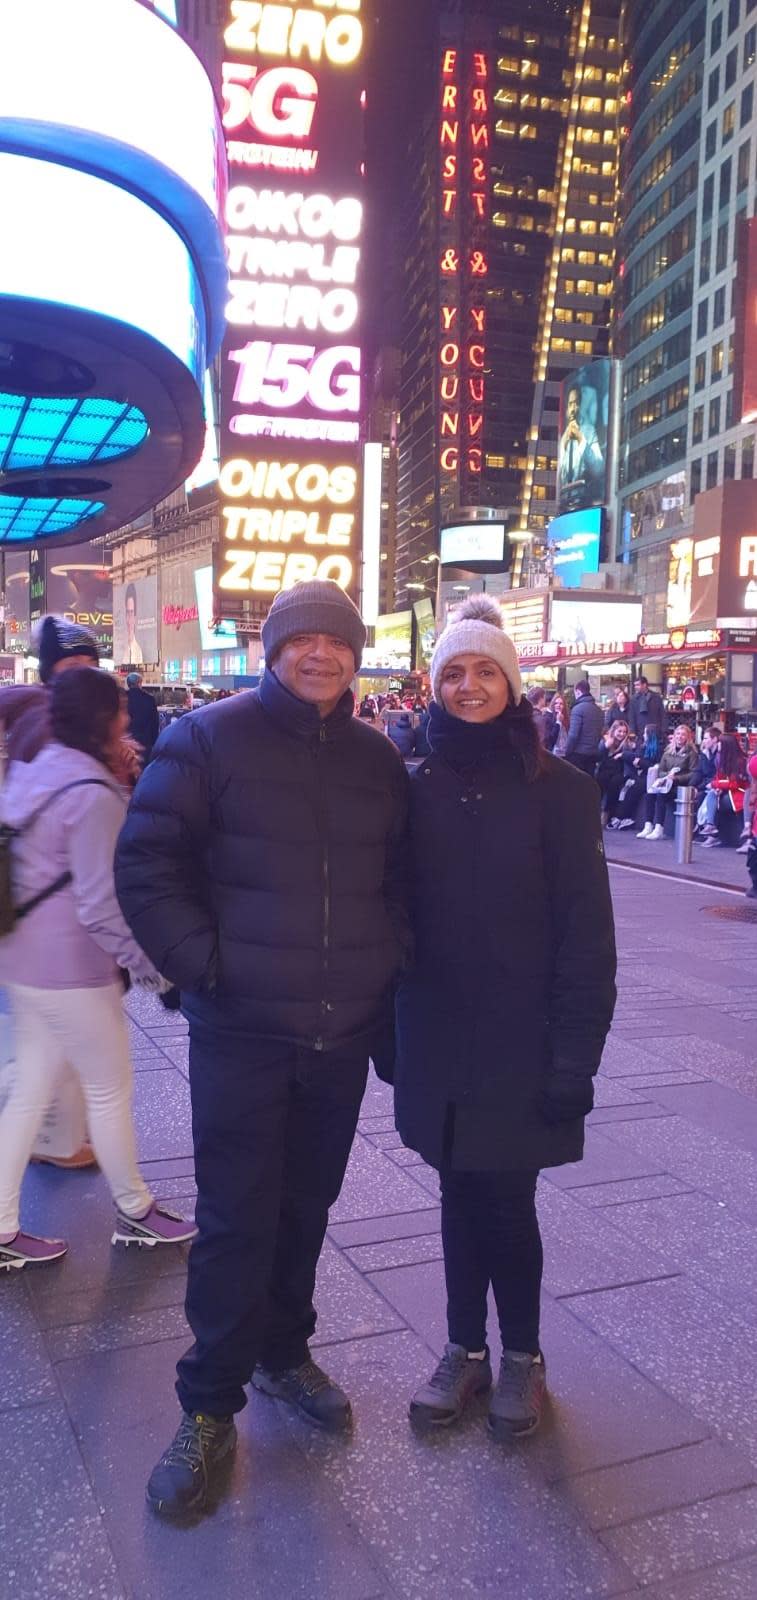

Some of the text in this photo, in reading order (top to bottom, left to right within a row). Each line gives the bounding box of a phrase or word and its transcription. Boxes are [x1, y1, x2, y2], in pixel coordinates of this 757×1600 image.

[223, 0, 363, 64] ZERO
[225, 186, 363, 241] OIKOS
[225, 234, 360, 283] TRIPLE
[440, 51, 459, 471] ERNST & YOUNG
[224, 279, 358, 333] ZERO
[228, 341, 361, 412] 15G
[219, 459, 357, 504] OIKOS
[222, 506, 355, 546] TRIPLE
[219, 550, 353, 591] ZERO
